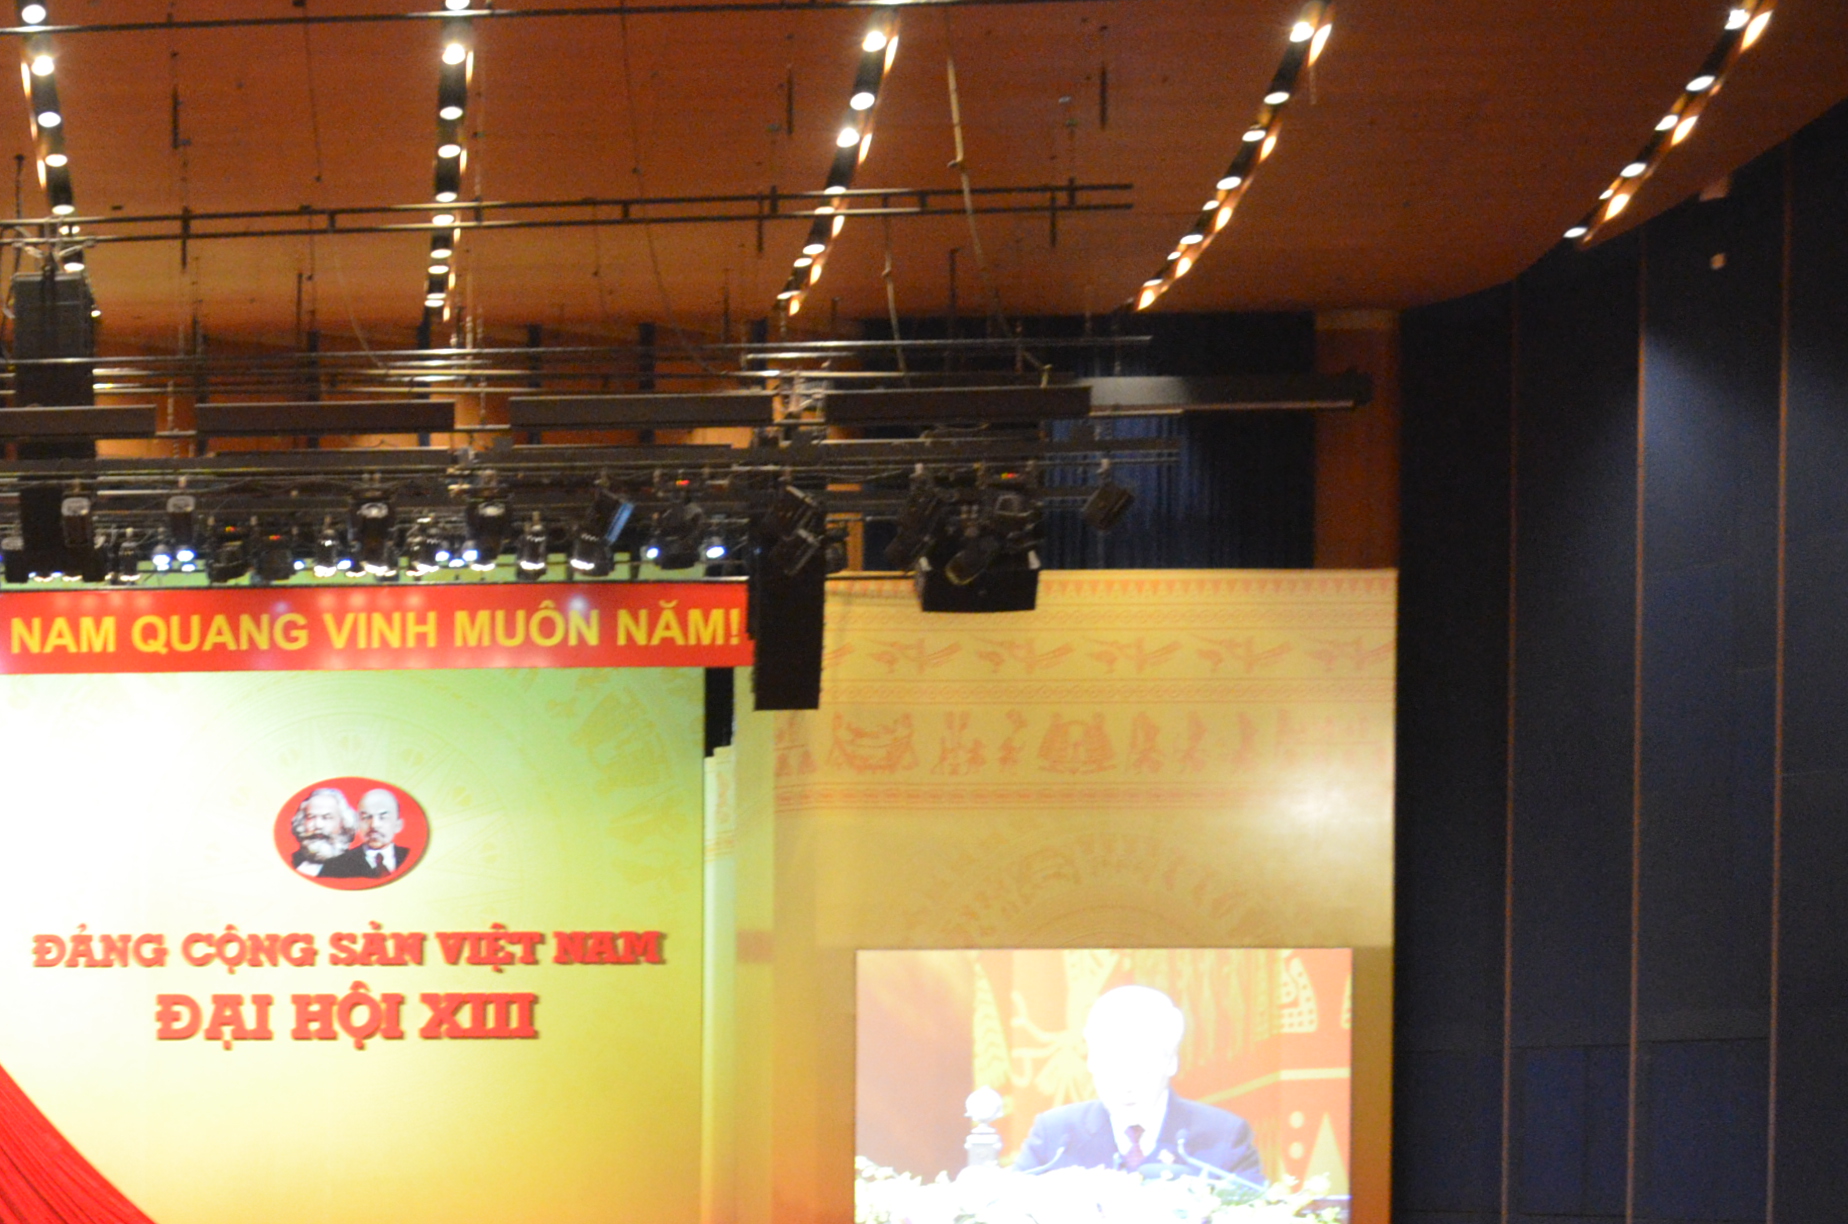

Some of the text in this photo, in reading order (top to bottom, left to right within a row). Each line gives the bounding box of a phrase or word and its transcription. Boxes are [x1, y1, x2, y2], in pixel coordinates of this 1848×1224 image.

[10, 616, 117, 655] NAM
[130, 612, 309, 655] QUANG
[323, 610, 439, 650] VINH
[454, 600, 601, 648] MUÔN
[616, 601, 741, 646] NĂM!
[32, 923, 169, 967] ĐẢNG
[181, 924, 319, 975] CỘNG
[435, 922, 545, 973] VIỆT
[552, 930, 666, 965] NAM
[155, 980, 540, 1051] ĐẠI HỘI XIII
